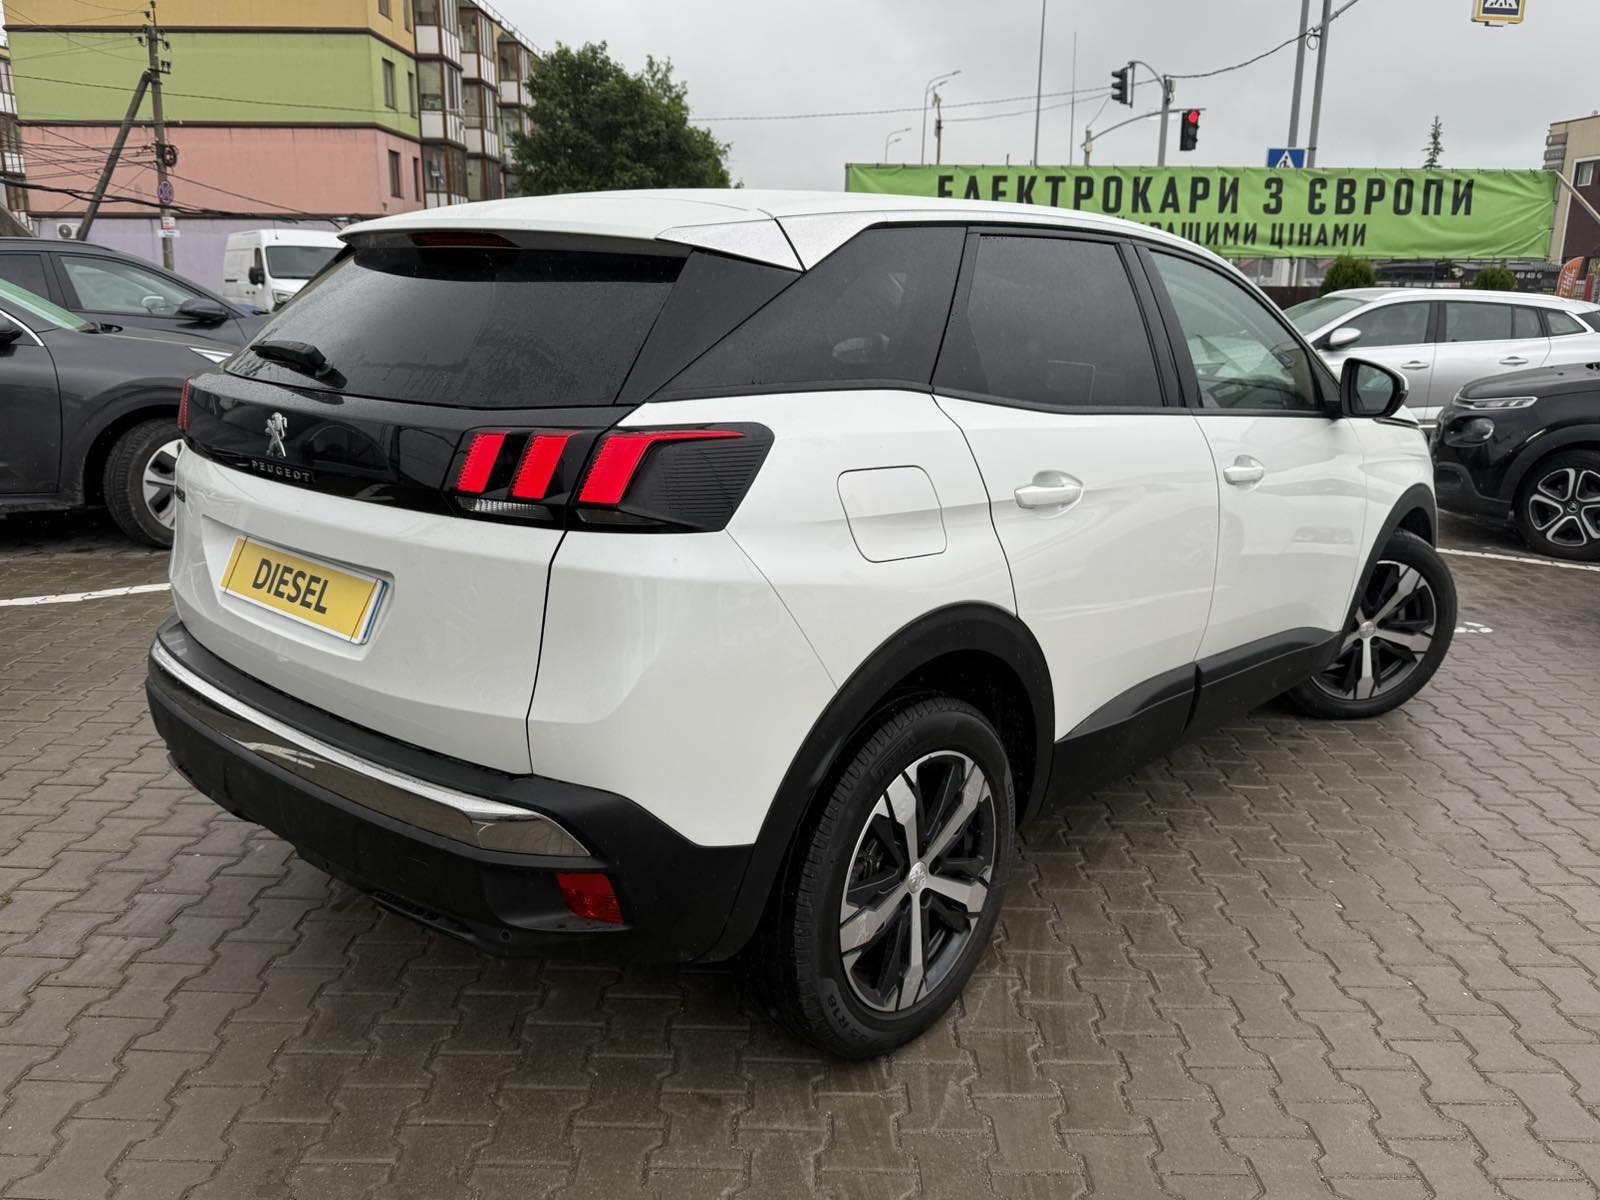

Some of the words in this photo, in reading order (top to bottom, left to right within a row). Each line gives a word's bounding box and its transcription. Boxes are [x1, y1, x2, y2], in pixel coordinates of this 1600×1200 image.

[937, 175, 1240, 214] ЕЛЕКТРОКАРИ
[1263, 177, 1284, 214] З
[1307, 178, 1474, 216] ЄВРОПИ
[1269, 222, 1367, 248] ЦІНАМИ
[251, 460, 312, 482] PEUGEOT
[252, 558, 328, 614] DIESEL
